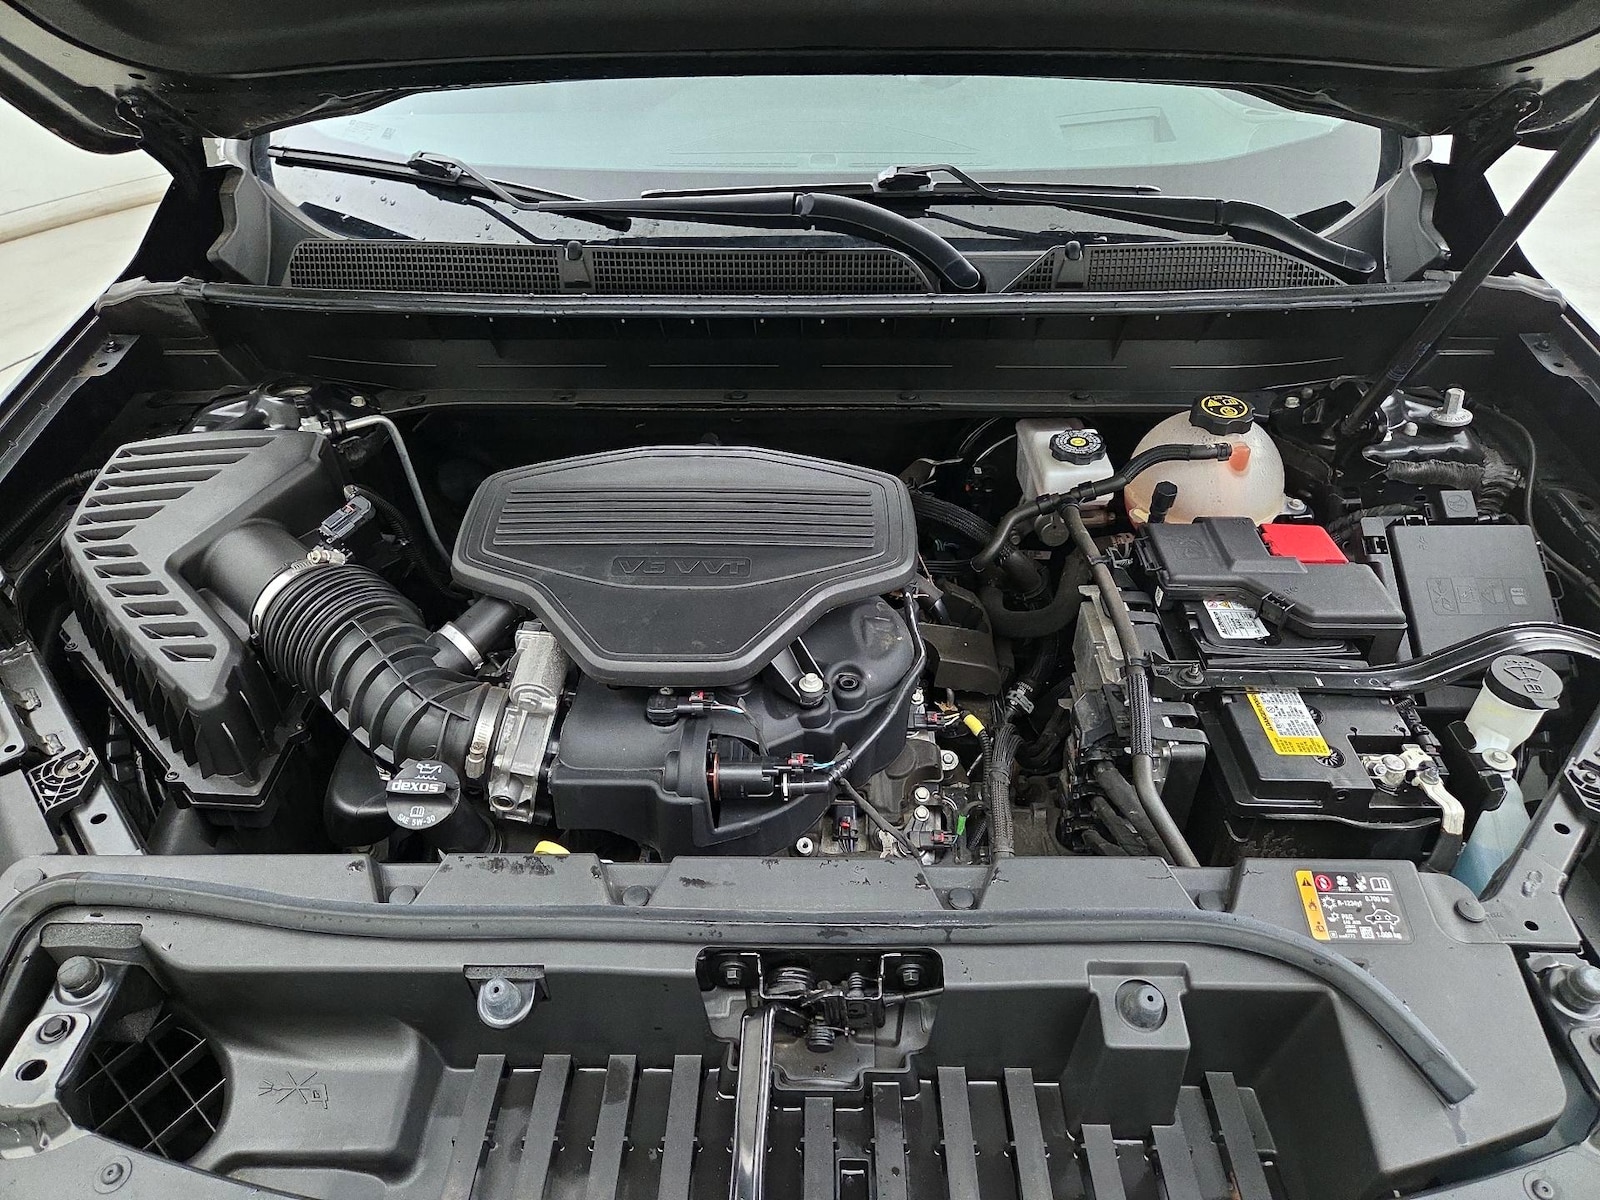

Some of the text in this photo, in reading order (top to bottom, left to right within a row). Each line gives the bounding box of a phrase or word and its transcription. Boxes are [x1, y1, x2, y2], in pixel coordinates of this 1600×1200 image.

[673, 559, 746, 574] VVT
[391, 779, 439, 793] dexos
[397, 813, 436, 827] SAE 5W-30
